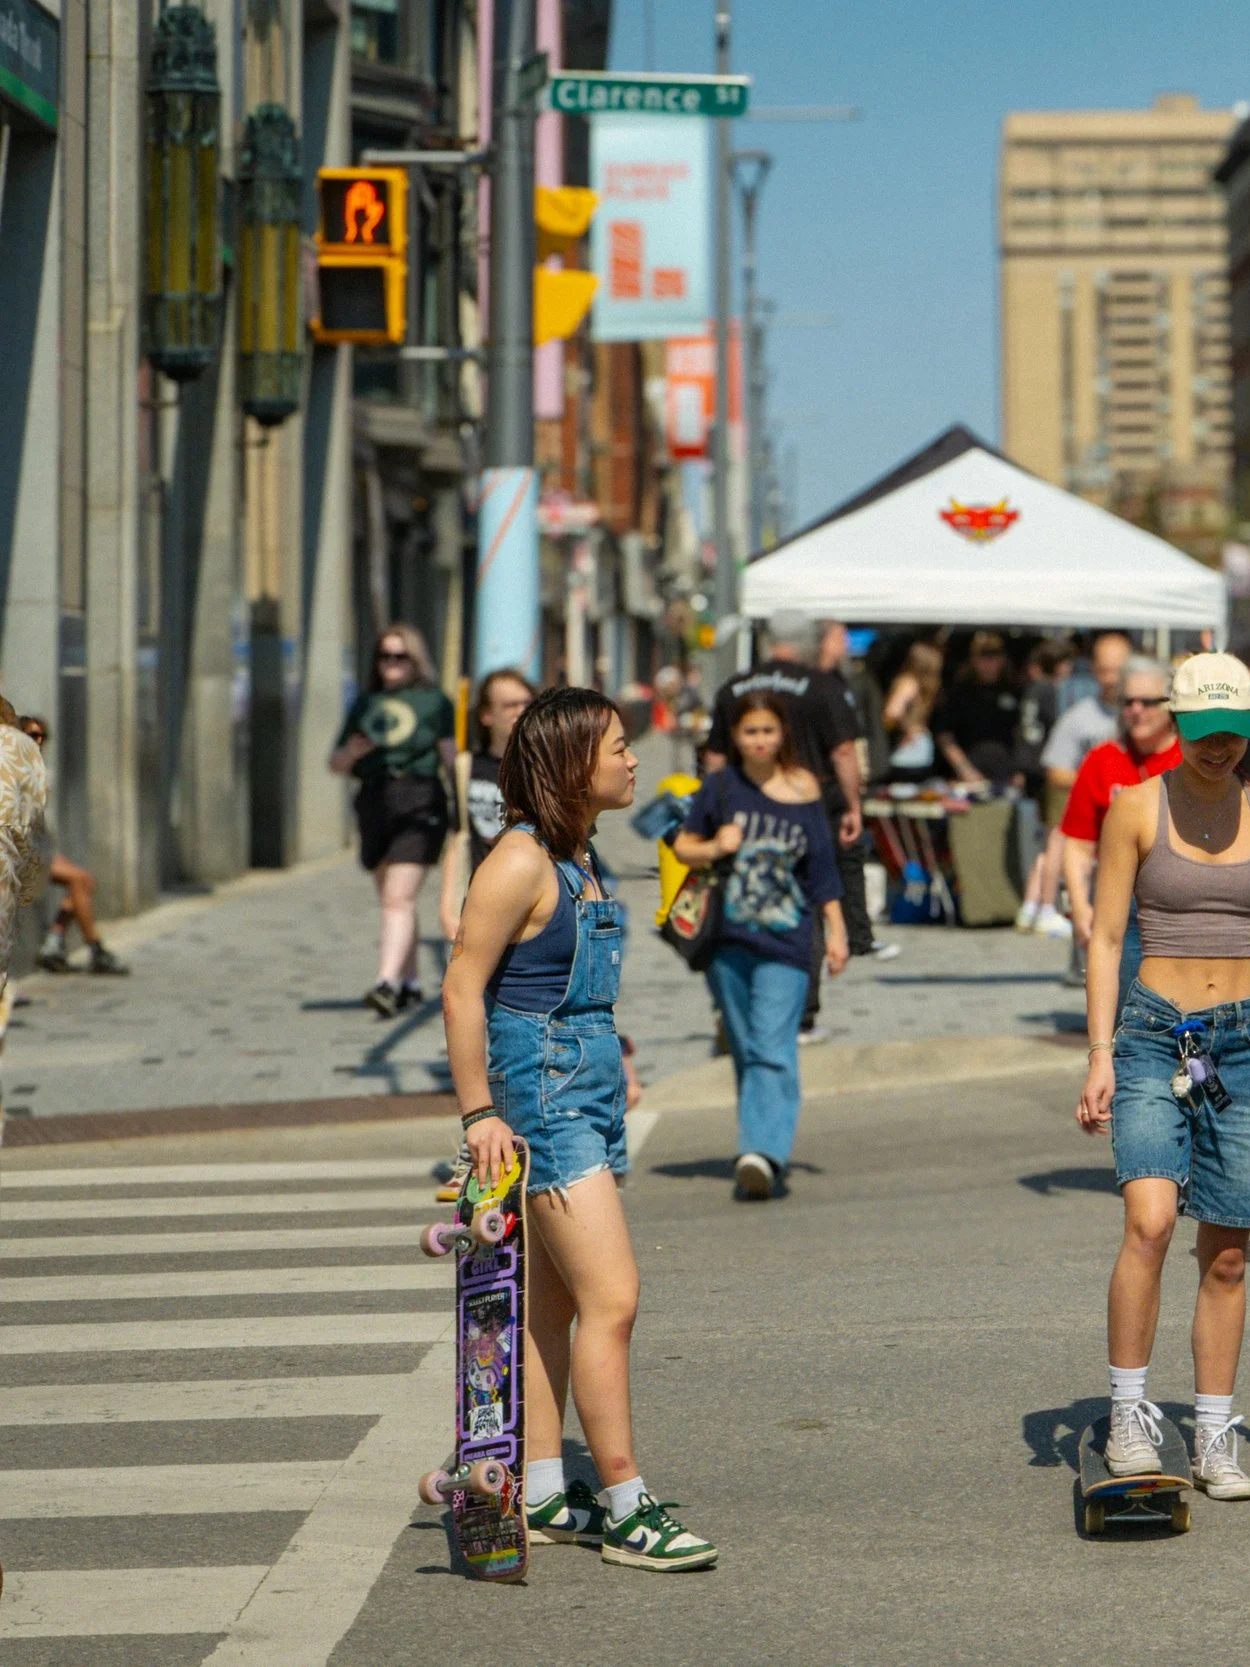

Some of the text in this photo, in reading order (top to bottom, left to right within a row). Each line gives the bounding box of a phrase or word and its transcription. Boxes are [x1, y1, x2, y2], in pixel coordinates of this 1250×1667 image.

[557, 80, 701, 112] Clarence
[1197, 682, 1239, 697] ARIZONA
[471, 1256, 501, 1277] GIRL
